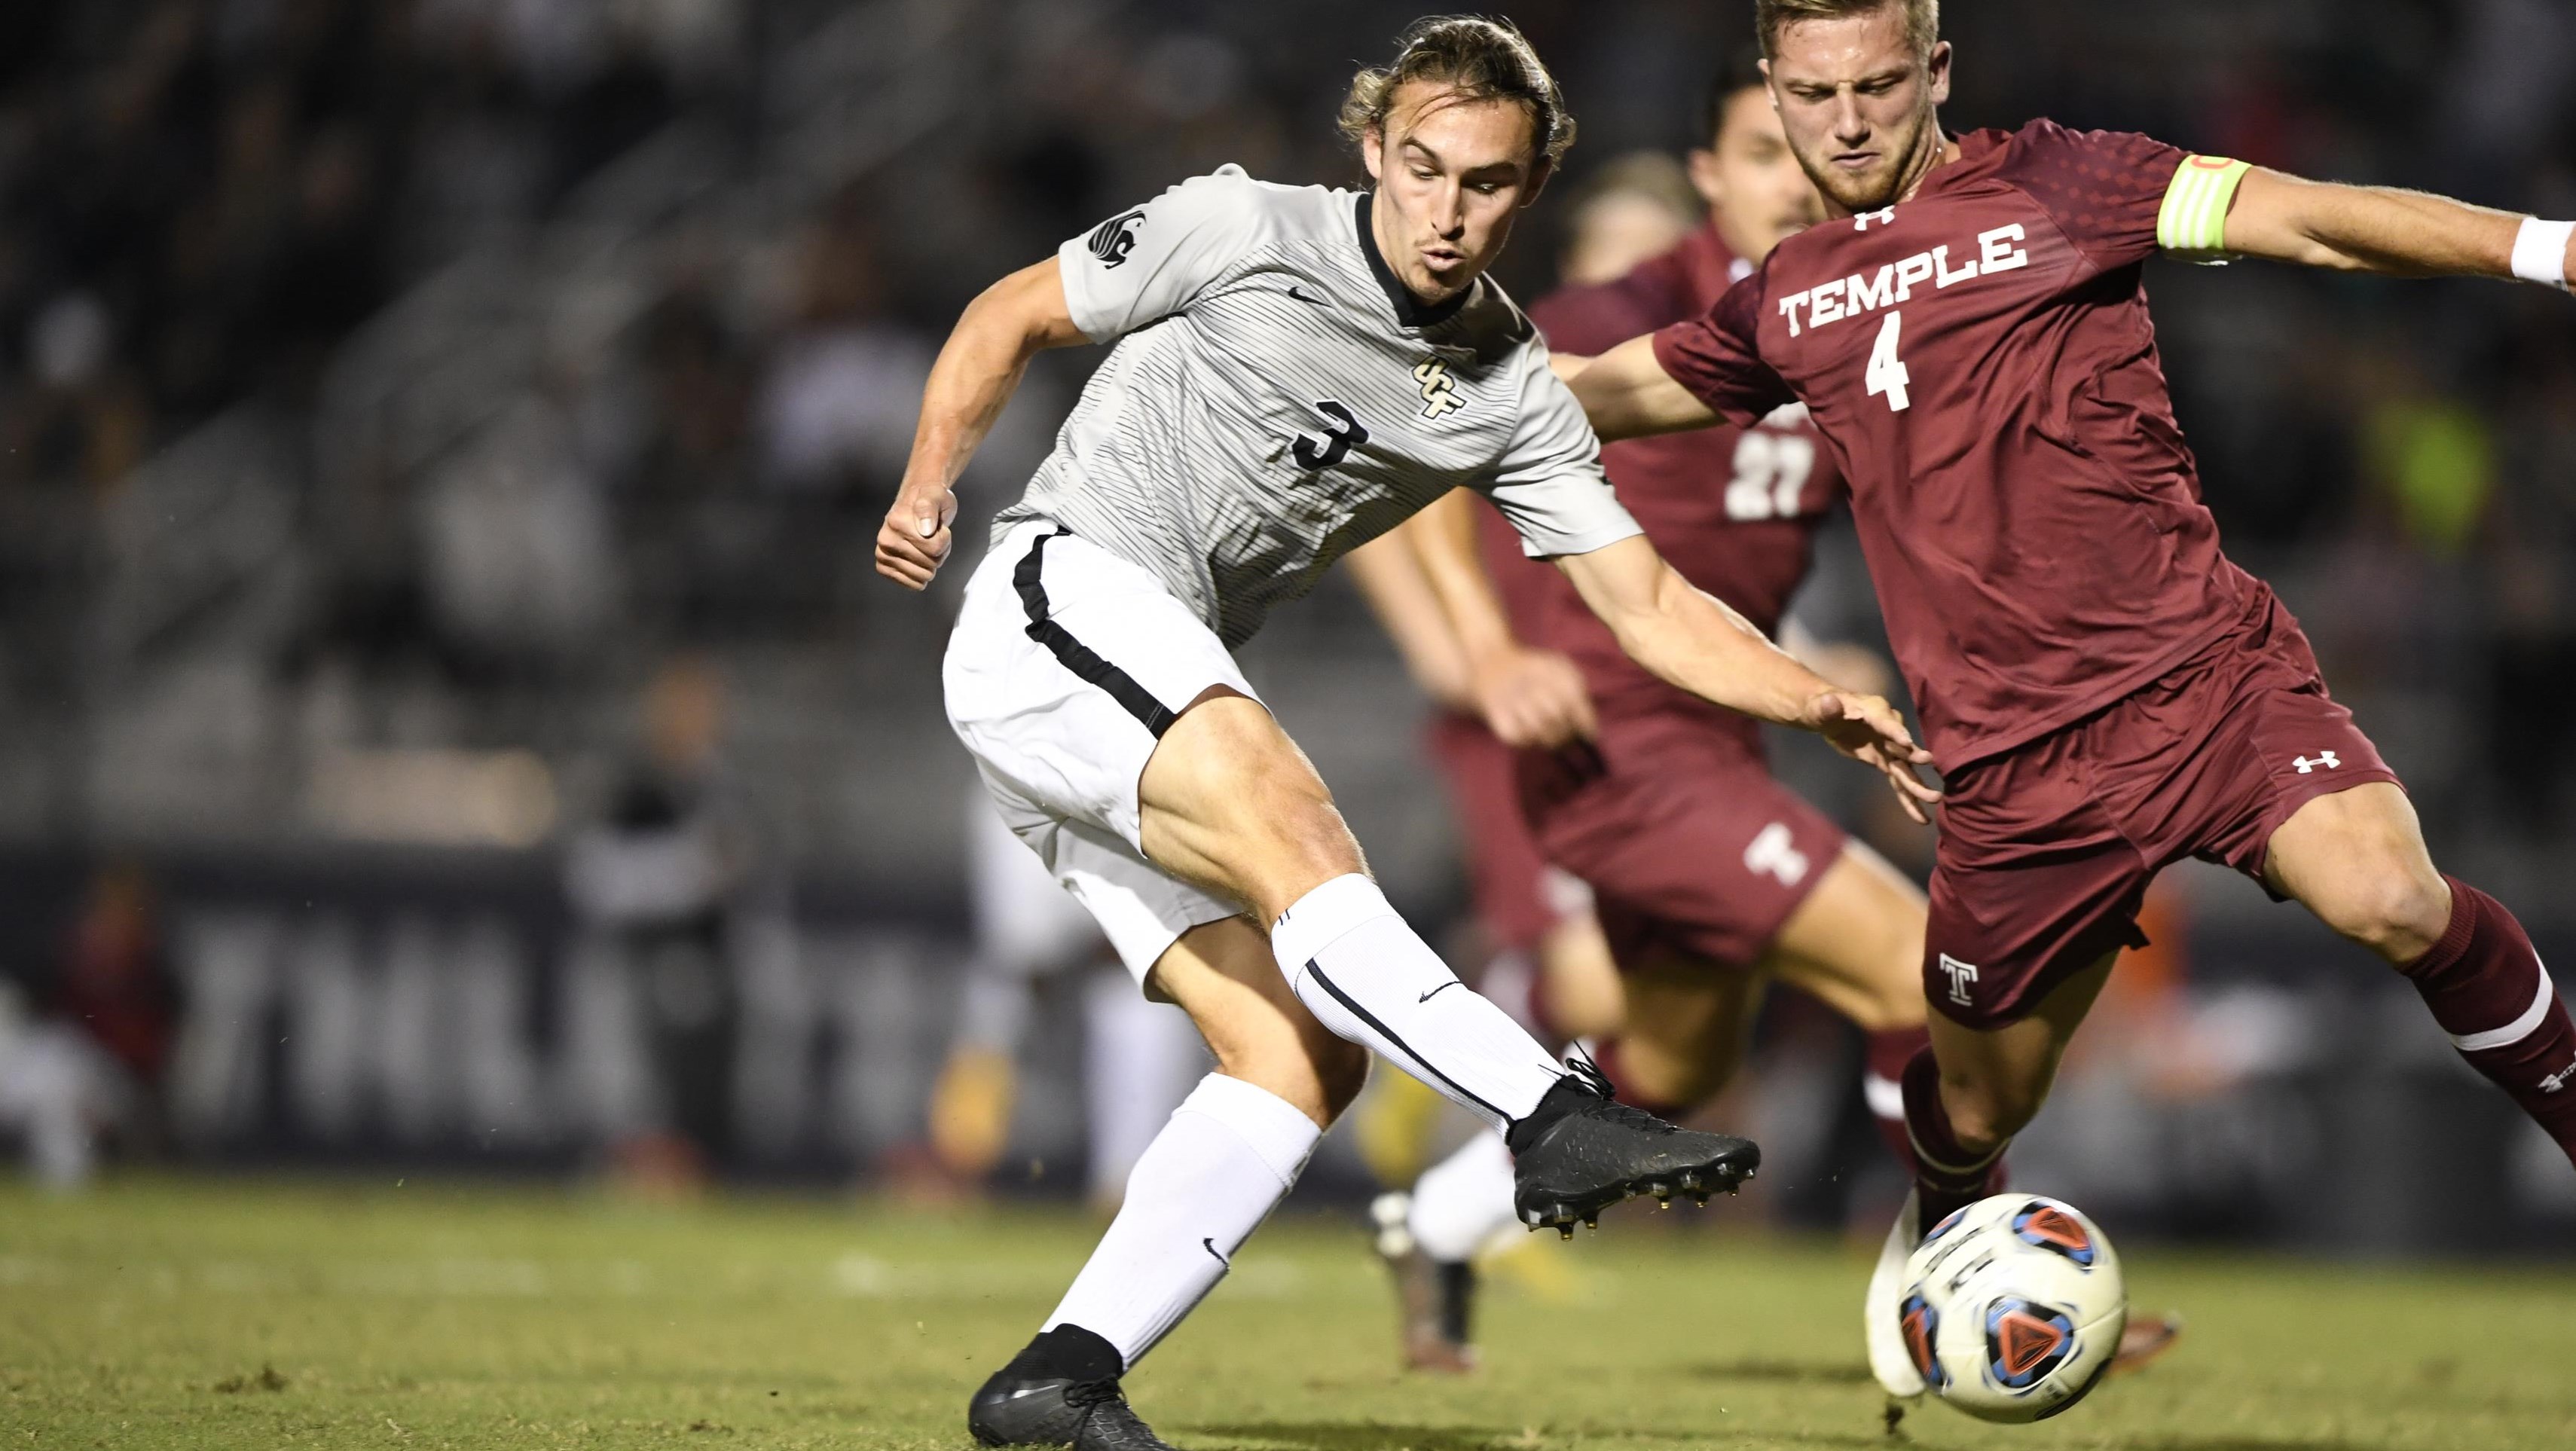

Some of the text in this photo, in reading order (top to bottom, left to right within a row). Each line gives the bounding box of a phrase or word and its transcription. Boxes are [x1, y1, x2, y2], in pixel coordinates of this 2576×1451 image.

[1778, 223, 2028, 338] TEMPLE
[1411, 354, 1468, 420] UCF
[1864, 310, 1910, 412] 4
[1289, 399, 1371, 472] 3
[1939, 952, 1979, 1007] T
